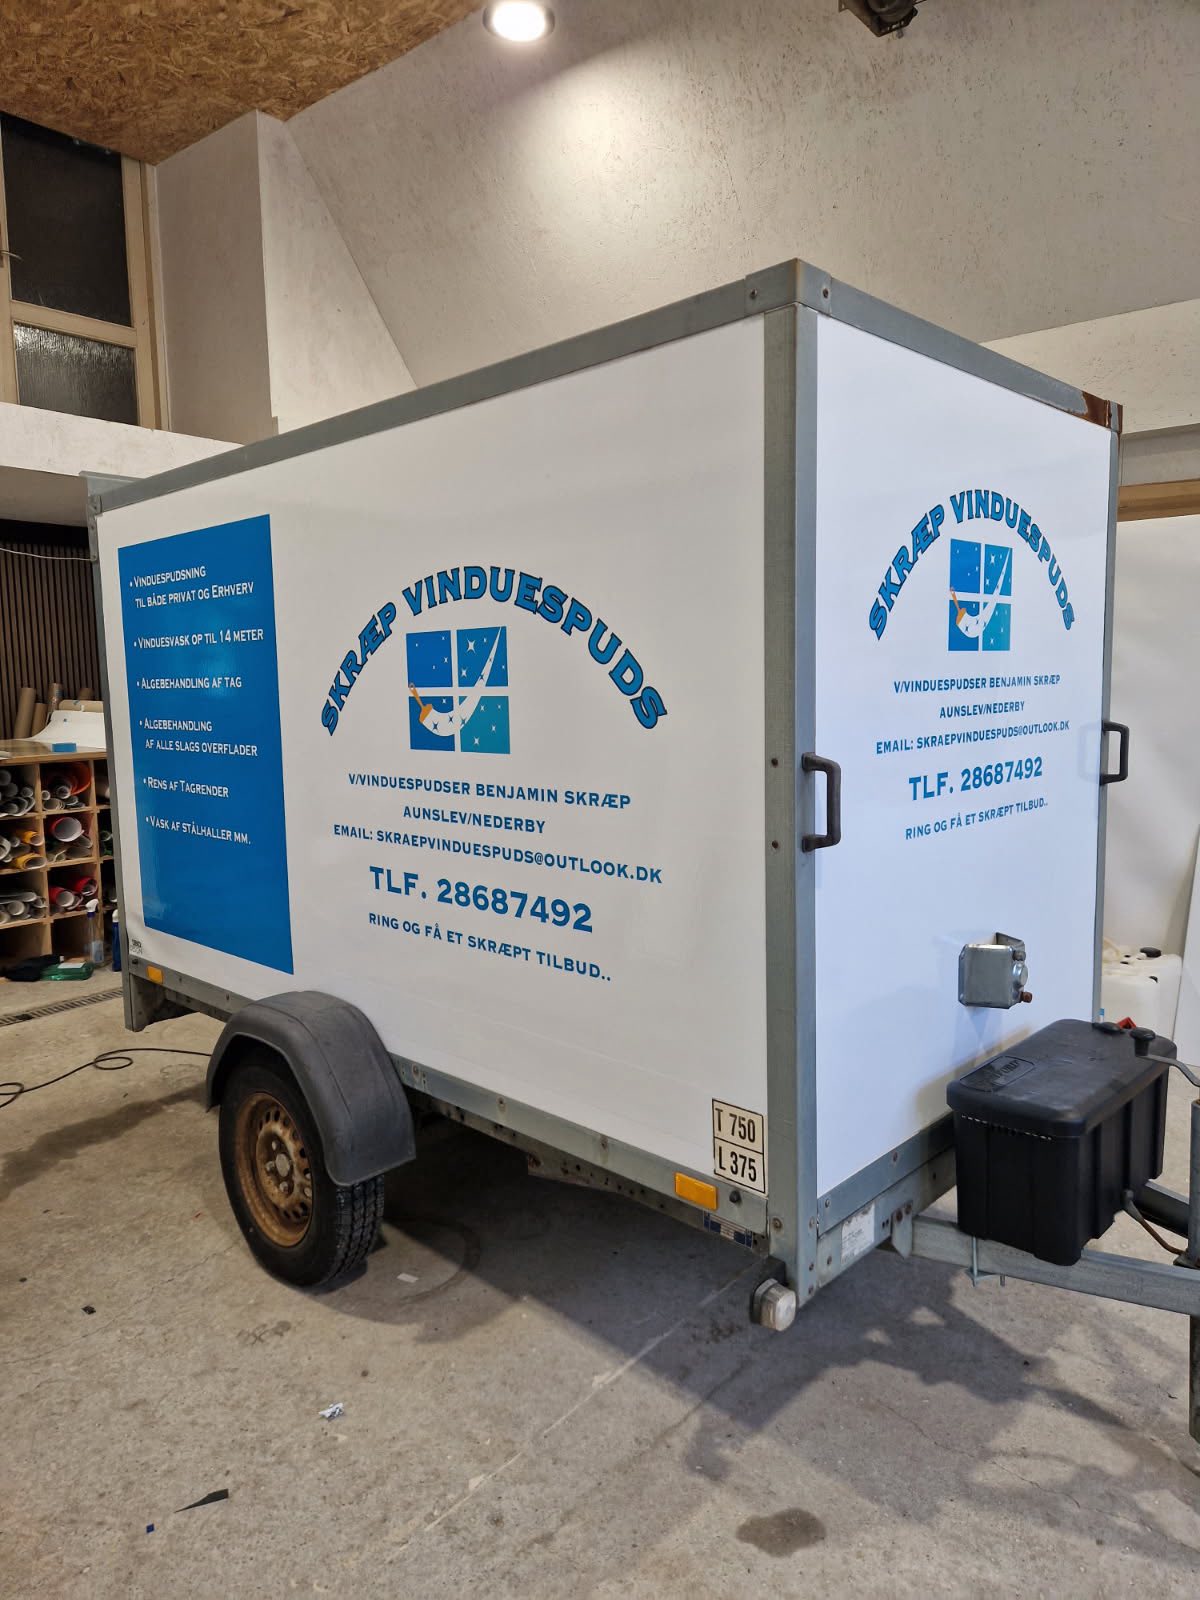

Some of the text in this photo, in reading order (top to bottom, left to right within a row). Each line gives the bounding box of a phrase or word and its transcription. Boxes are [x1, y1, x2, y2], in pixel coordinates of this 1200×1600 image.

[133, 566, 206, 588] VINDUESPUDSNING
[869, 489, 1075, 641] SKRÆP VINDUESPUDS
[135, 582, 254, 608] TIL BÅDE PRIVAT OG ERHVERV
[138, 628, 264, 649] VINDUESVASK OP TIL 14 METER
[321, 566, 668, 736] SKRÆP VINDUESPUDS
[141, 676, 242, 689] ALGEBEHANDLING AF TAG
[893, 674, 1061, 694] V/VINDUESPUDSER BENJAMIN SKRÆP
[144, 718, 213, 732] ALGEBEHANDLING
[939, 701, 1025, 719] AUNSLEV/NEDERBY
[145, 739, 258, 758] AF ALLE SLAGS OVERFLADER
[875, 720, 1070, 755] EMAIL: SKRAEPVINDUESPUDS@OUTLOOK.DK
[148, 776, 229, 798] RENS AF TAGRENDER
[348, 773, 631, 810] V/VINDUESPUDSER BENJAMIN SKRÆP
[909, 756, 1043, 801] TLF. 28687492
[149, 815, 252, 846] VASK AF STÅLHALLER MM.
[403, 805, 546, 834] AUNSLEV/NEDERBY
[905, 823, 932, 841] RING
[933, 819, 948, 834] OG
[950, 812, 963, 831] FÅ
[965, 812, 977, 826] ET
[978, 804, 1015, 823] SKRÆPT
[333, 824, 663, 884] EMAIL: SKRAEPVINDUESPUDS@OUTLOOK.DK
[369, 865, 593, 934] TLF. 28687492
[368, 912, 612, 983] RING OG FÅ ET SKRÆPT TILBUD..
[715, 1108, 756, 1143] T 750
[718, 1146, 757, 1182] L 375
